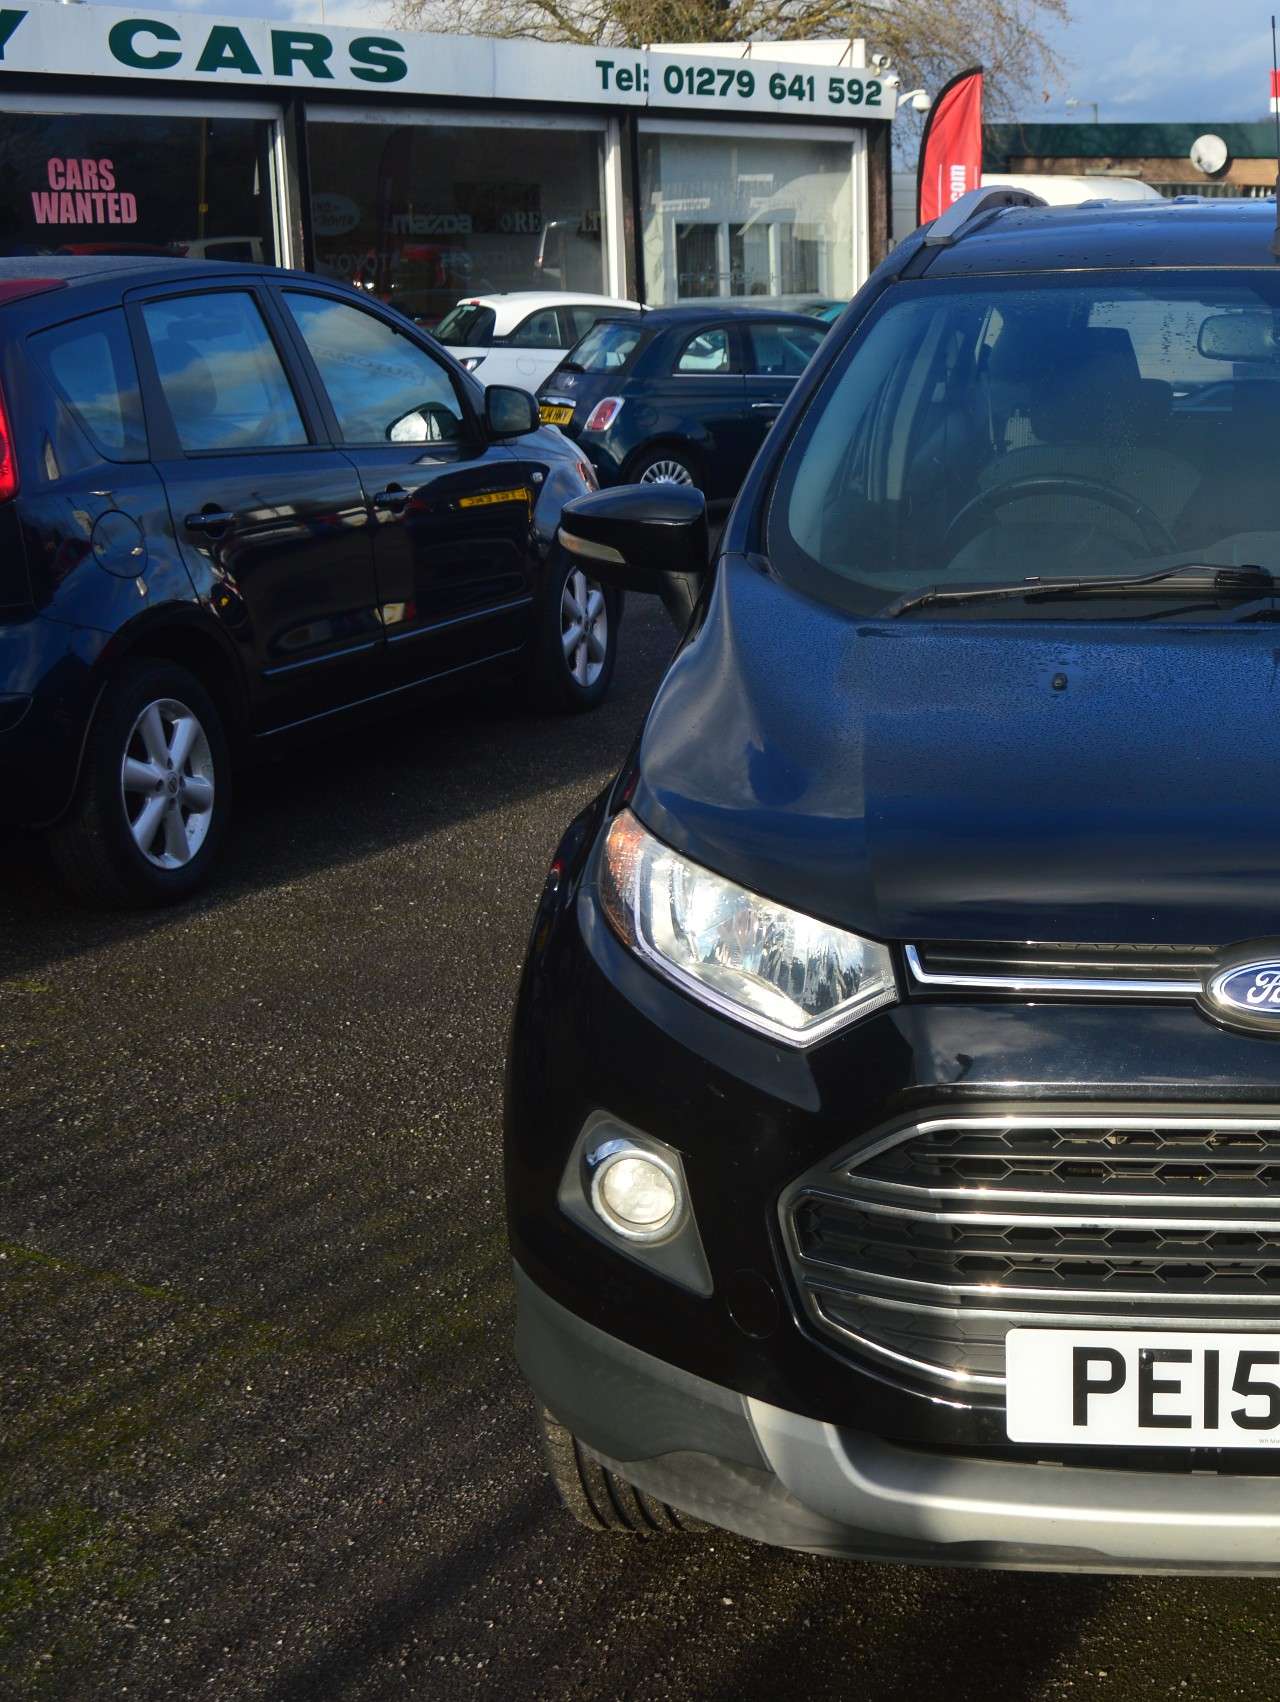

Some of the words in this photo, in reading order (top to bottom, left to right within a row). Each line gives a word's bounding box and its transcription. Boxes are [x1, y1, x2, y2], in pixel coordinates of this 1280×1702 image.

[107, 17, 409, 84] CARS
[595, 60, 649, 92] Tel:
[663, 65, 756, 98] 01279
[768, 73, 815, 102] 641
[827, 78, 883, 106] 592
[47, 157, 117, 192] CARS
[31, 192, 138, 225] WANTED
